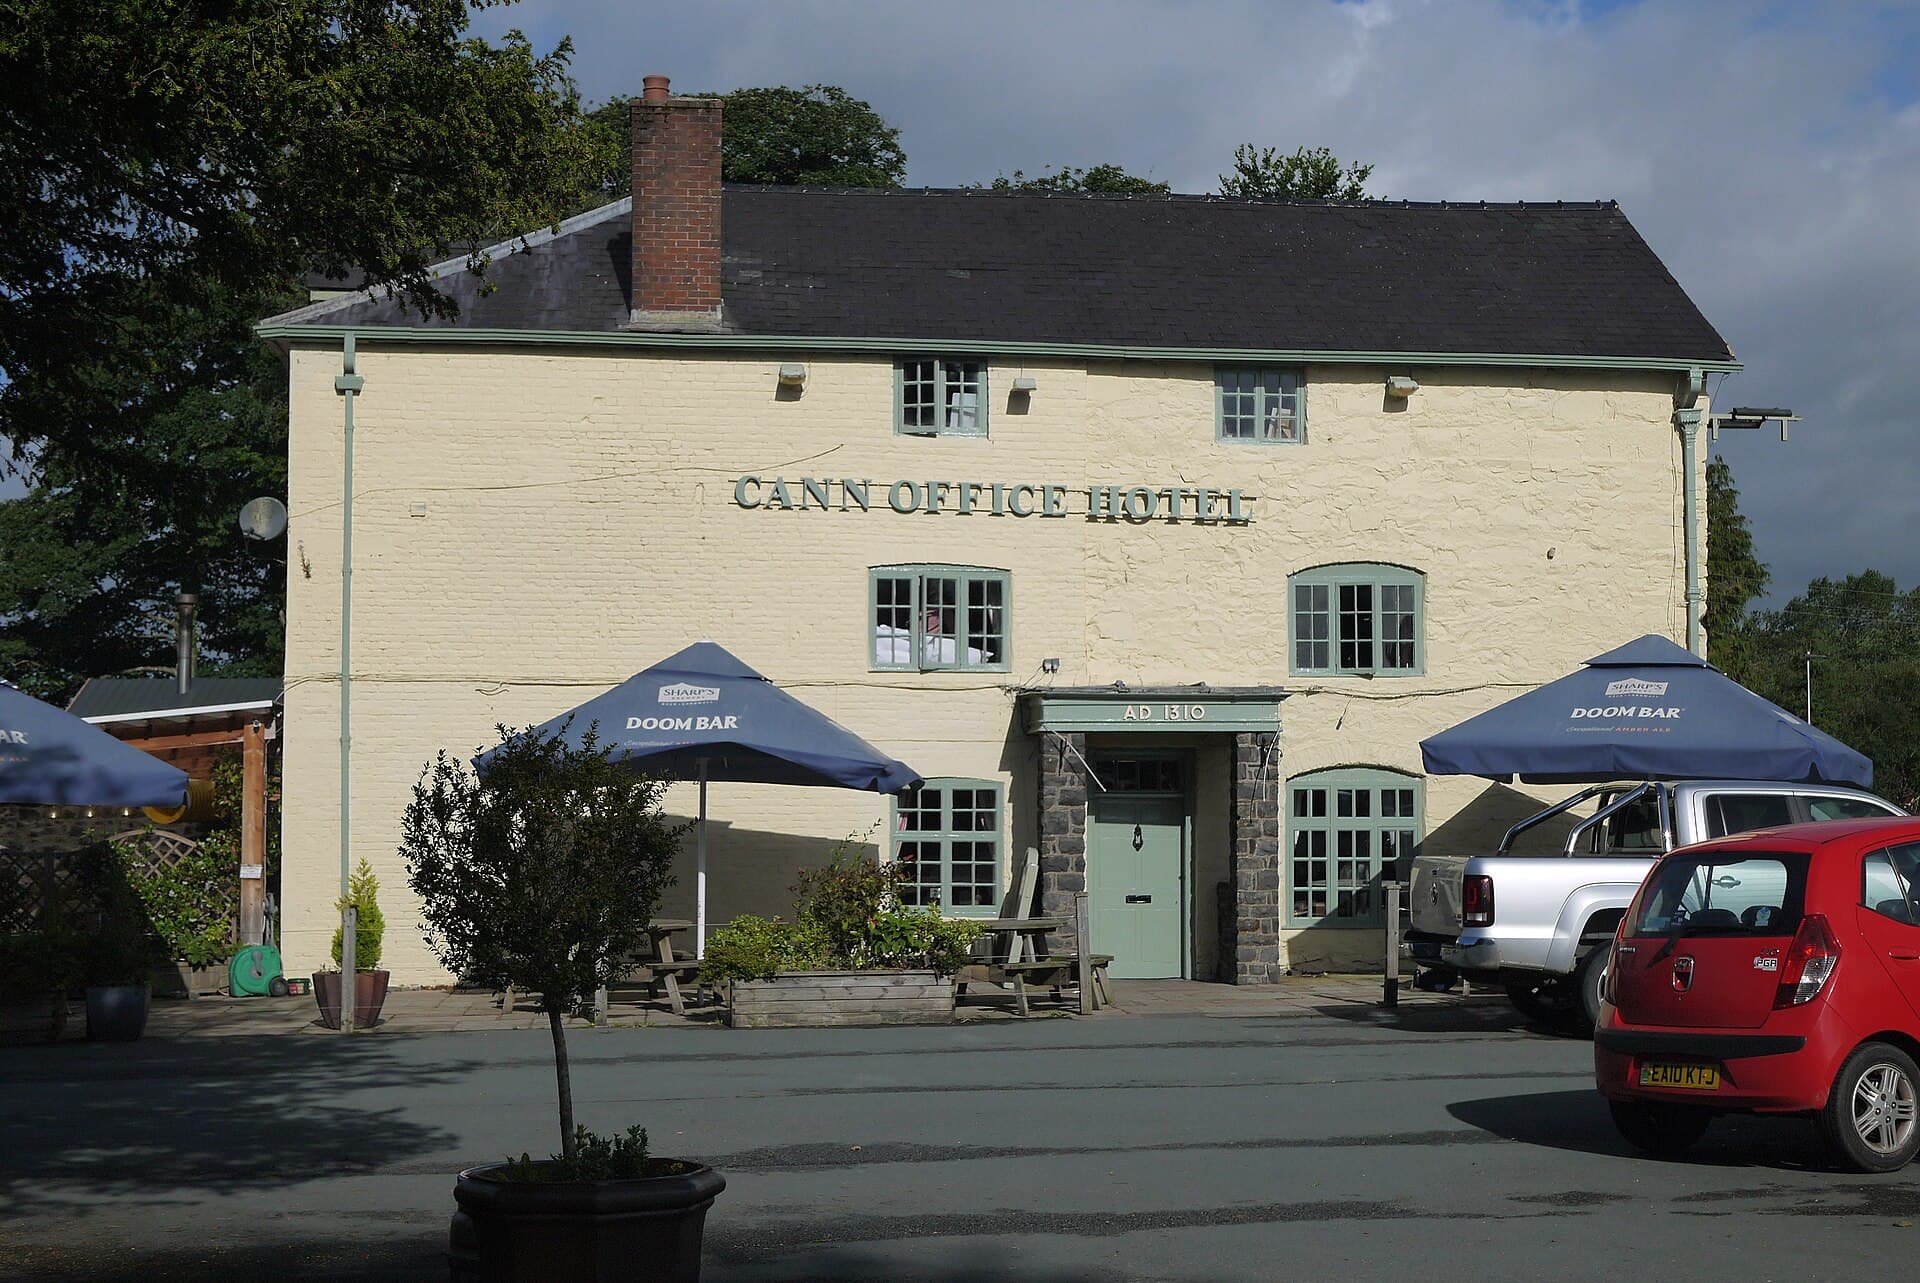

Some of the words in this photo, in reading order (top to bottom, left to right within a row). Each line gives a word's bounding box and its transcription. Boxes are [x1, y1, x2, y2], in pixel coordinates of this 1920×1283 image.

[735, 475, 871, 512] CANN
[888, 479, 1067, 516] OFFICE
[1088, 485, 1253, 521] HOTEL
[663, 688, 715, 697] SHARP'S
[1123, 704, 1152, 720] AD
[1163, 704, 1205, 720] 1310
[1570, 706, 1636, 718] DOOM
[1638, 707, 1681, 718] BAR
[626, 717, 692, 730] DOOM
[695, 715, 738, 730] BAR
